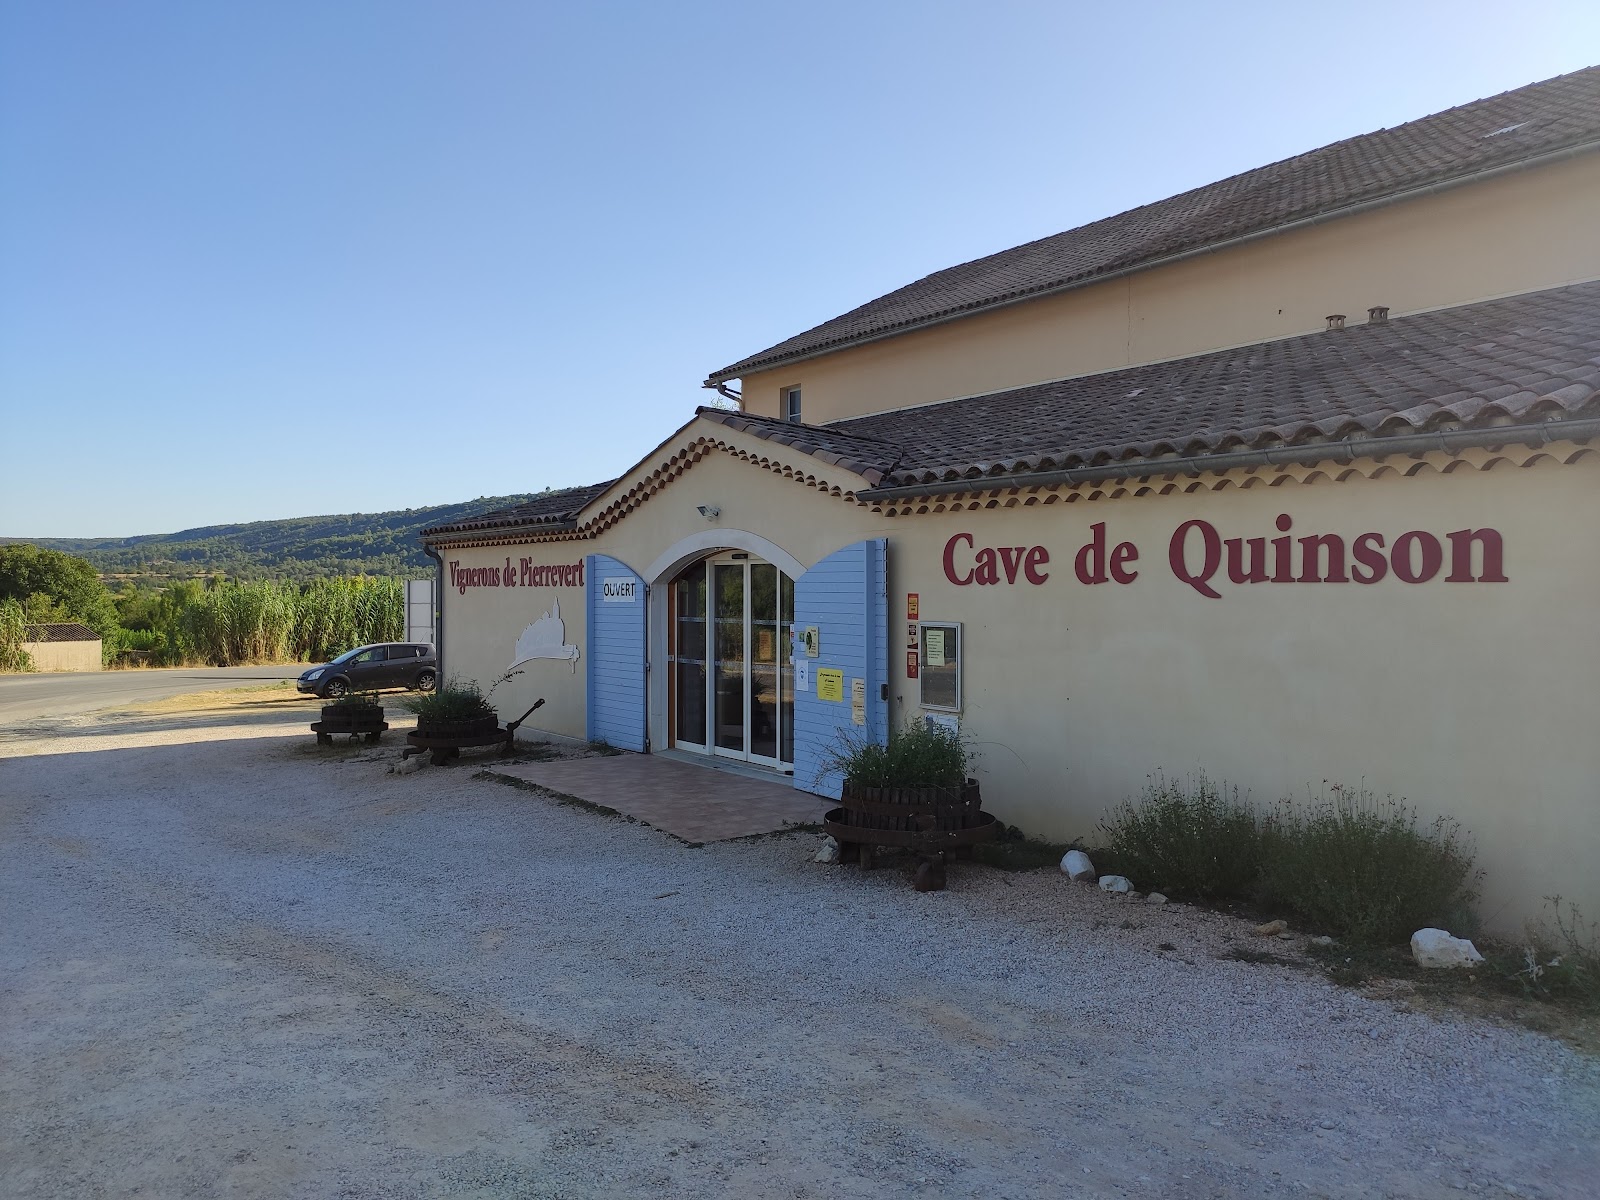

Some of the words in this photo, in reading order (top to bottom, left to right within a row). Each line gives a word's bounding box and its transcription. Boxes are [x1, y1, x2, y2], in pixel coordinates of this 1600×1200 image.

[942, 532, 1050, 586] Cave
[1074, 522, 1139, 585] de
[1168, 513, 1508, 599] Quinson
[449, 560, 500, 595] Vignerons
[503, 557, 516, 587] de
[519, 557, 584, 587] Pierrevert
[603, 582, 635, 597] OUVERT
